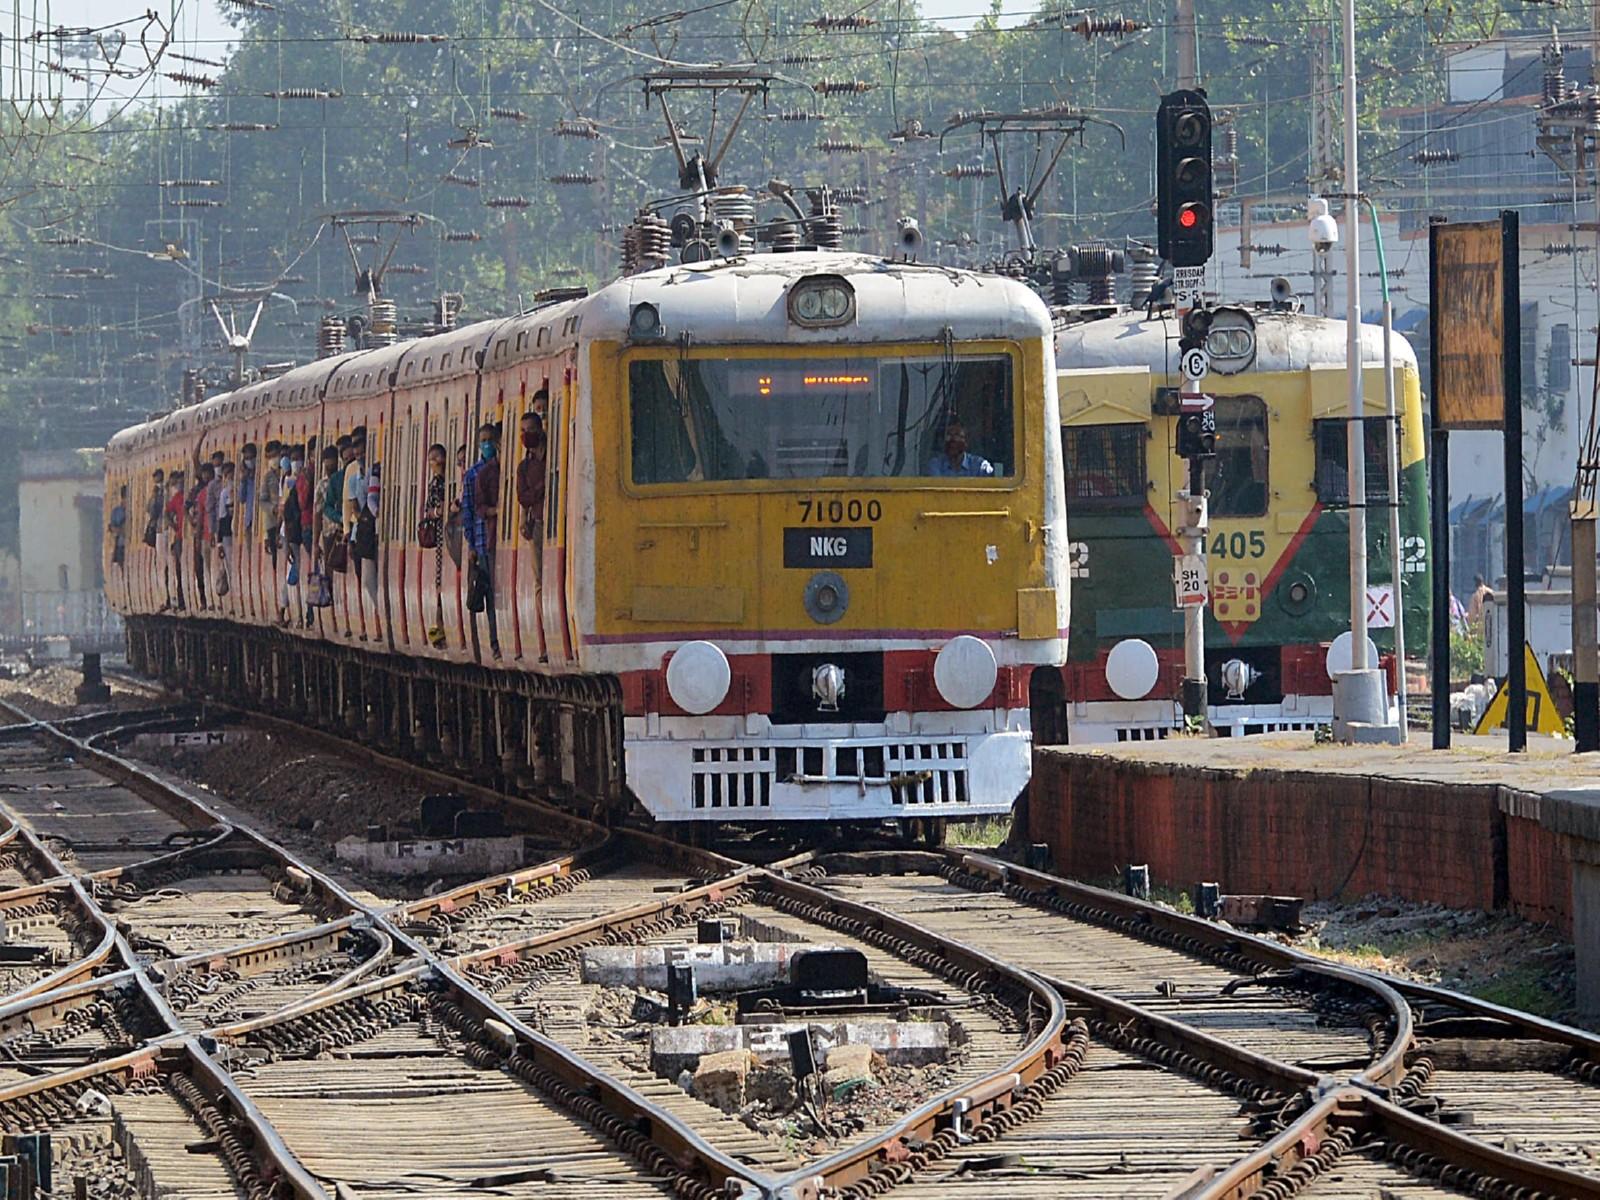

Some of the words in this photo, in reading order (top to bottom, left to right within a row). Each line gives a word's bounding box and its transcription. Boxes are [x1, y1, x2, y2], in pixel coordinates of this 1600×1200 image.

[1202, 410, 1214, 420] SH
[1201, 420, 1216, 431] 20
[798, 500, 882, 523] 71000
[810, 536, 847, 556] NKG
[1182, 570, 1199, 580] SH
[1183, 581, 1200, 592] 20
